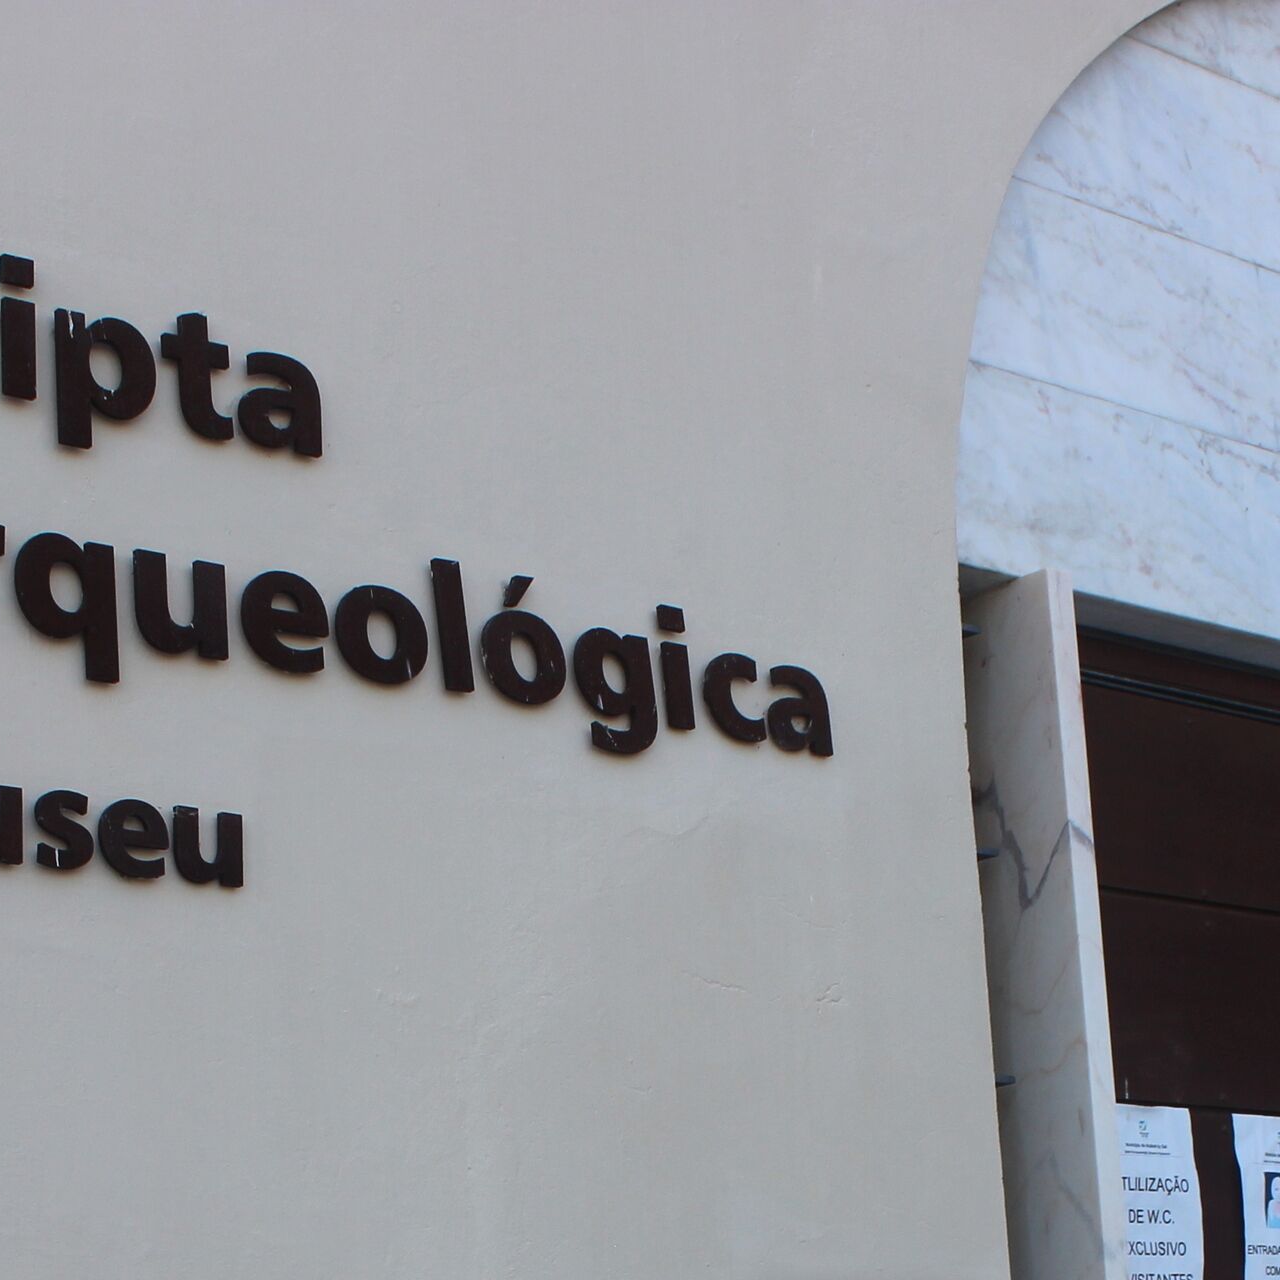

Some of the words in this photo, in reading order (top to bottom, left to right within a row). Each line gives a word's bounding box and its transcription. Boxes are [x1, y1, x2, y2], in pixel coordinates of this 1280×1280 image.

[1121, 1175, 1189, 1195] TLILIZAÇÃO
[1128, 1208, 1145, 1224] DE
[1146, 1209, 1176, 1224] W.C.
[1127, 1241, 1187, 1257] XCLUSIVO
